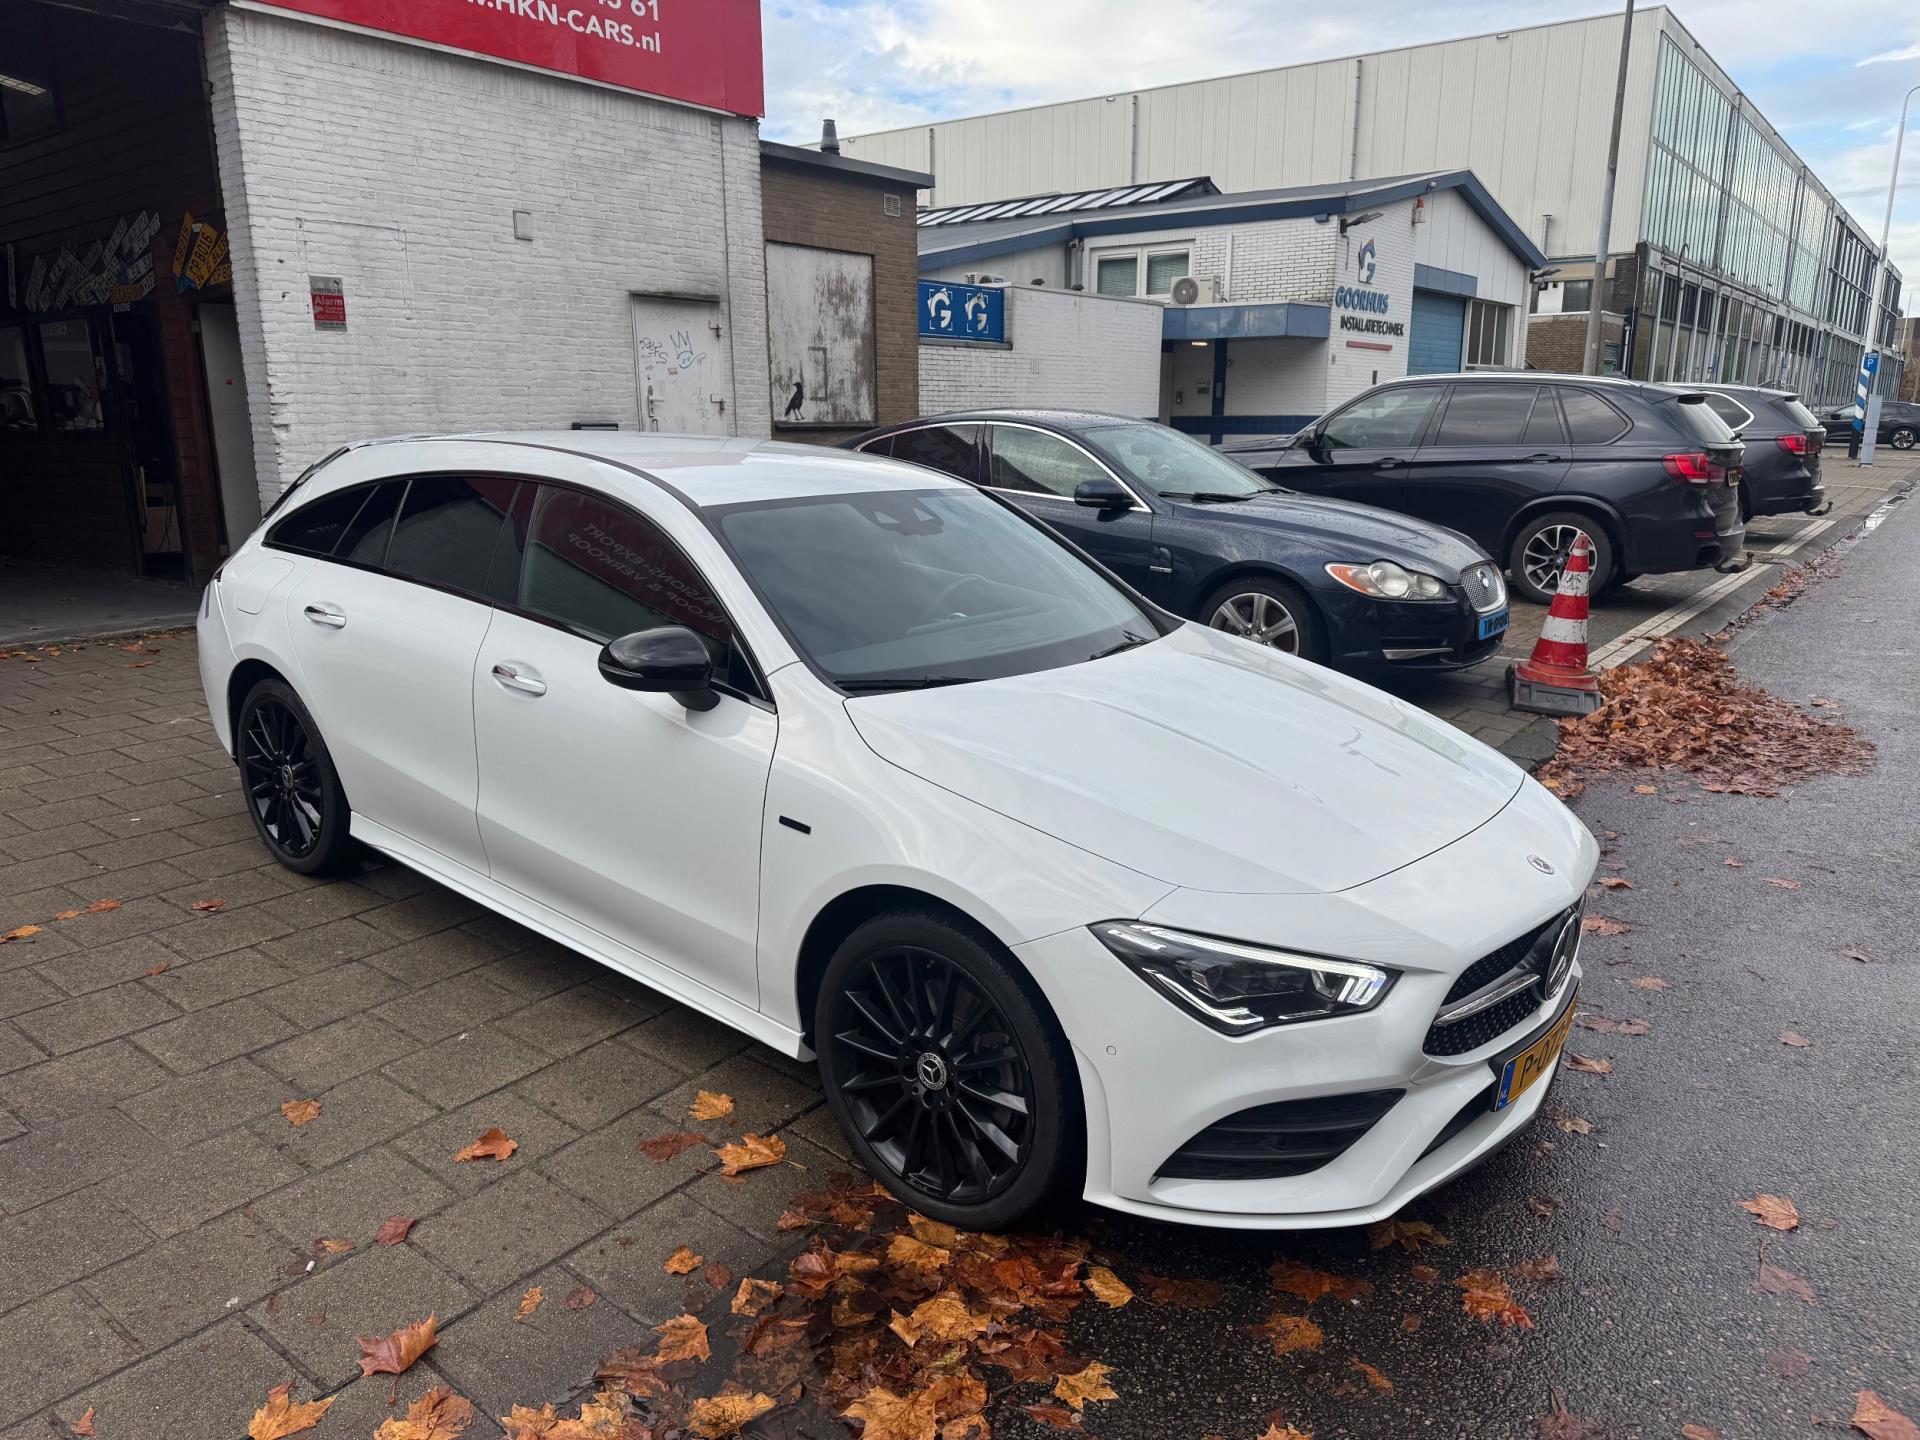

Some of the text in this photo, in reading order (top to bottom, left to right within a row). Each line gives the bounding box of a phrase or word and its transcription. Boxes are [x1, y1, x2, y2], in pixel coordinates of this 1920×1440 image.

[467, 0, 660, 53] .HKN-CARS.nl
[194, 231, 213, 262] 8016
[314, 295, 343, 306] Alarm
[1335, 286, 1389, 314] GOORHUIS
[1340, 314, 1404, 336] INSTALLATIETECHNIEK
